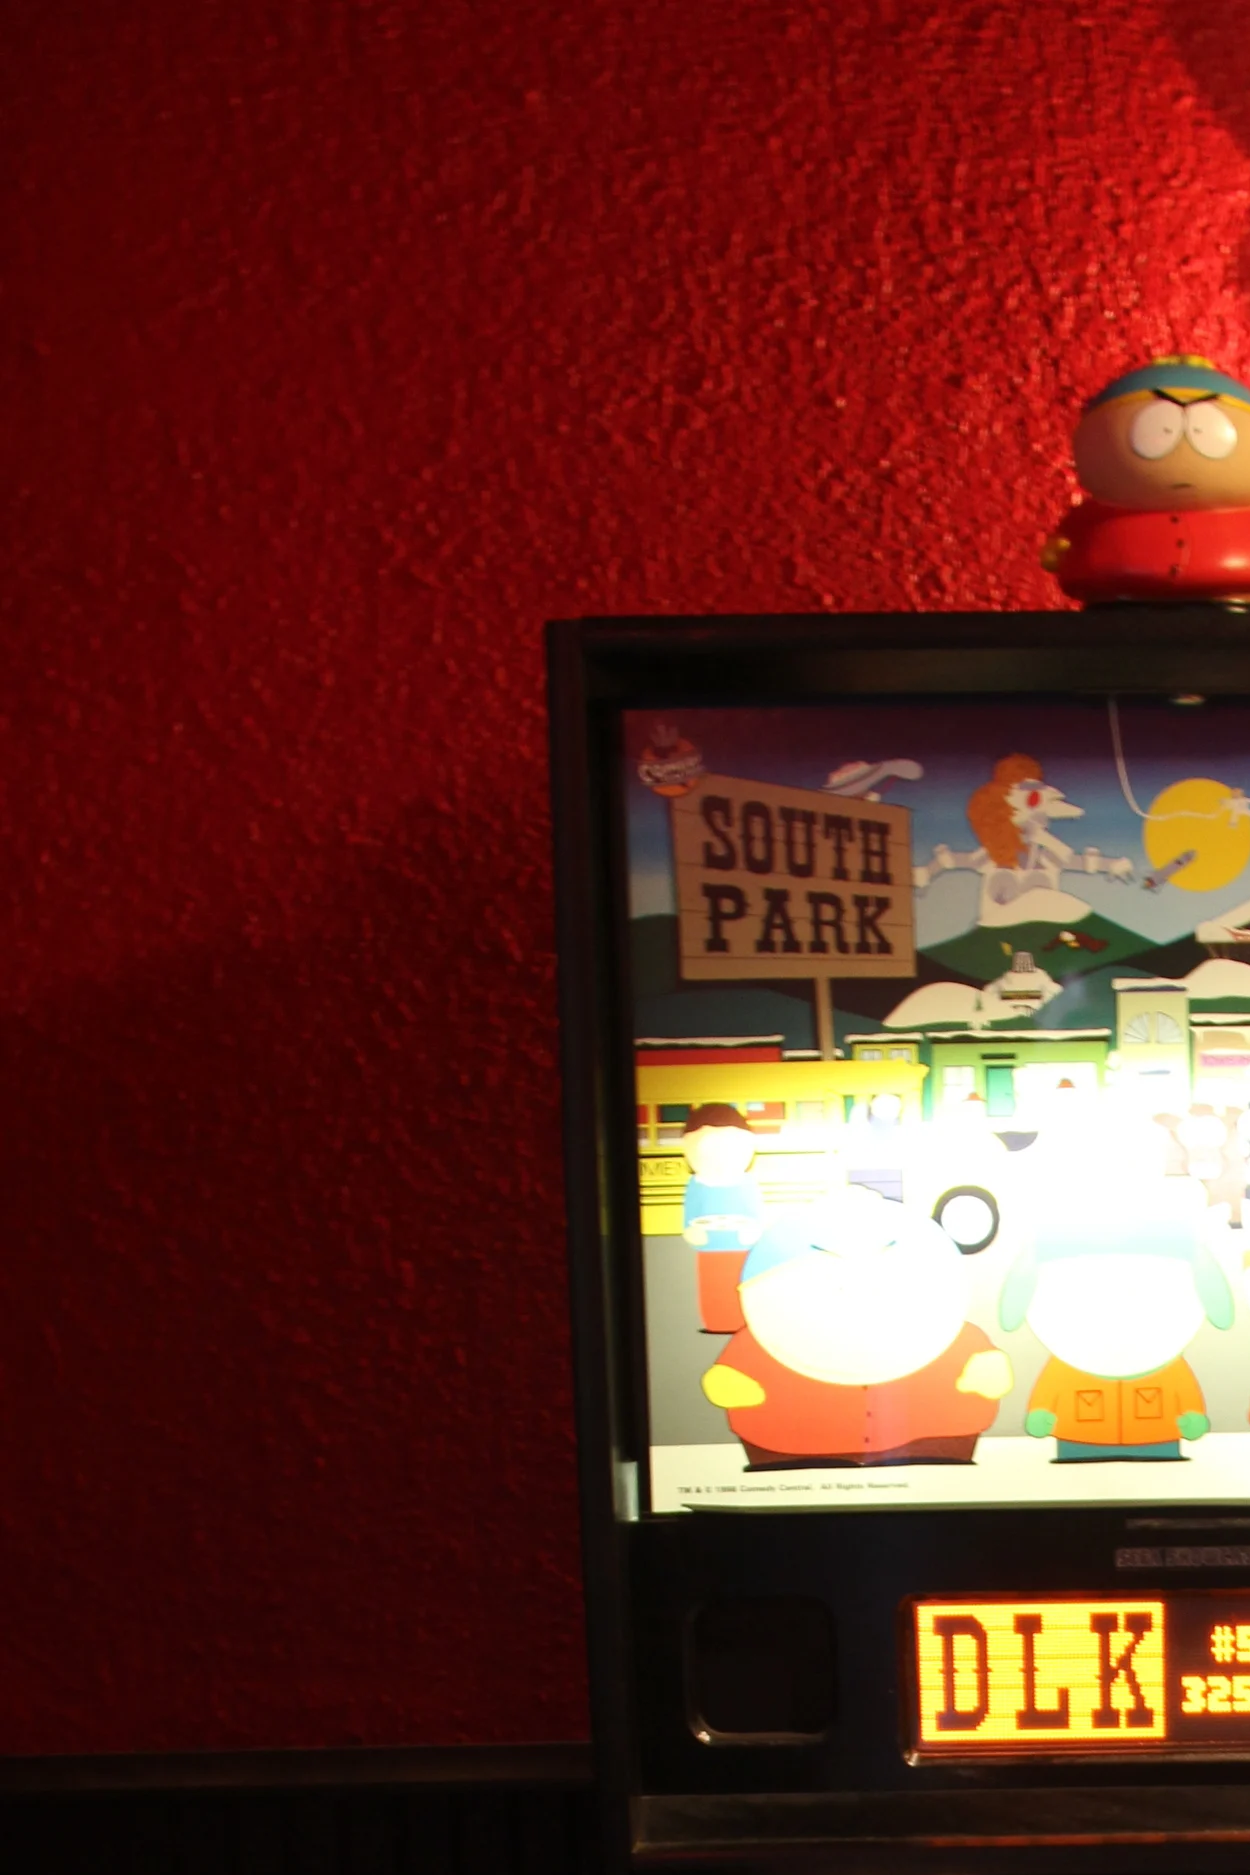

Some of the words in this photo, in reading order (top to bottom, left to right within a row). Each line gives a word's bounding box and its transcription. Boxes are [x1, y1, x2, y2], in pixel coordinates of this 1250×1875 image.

[701, 795, 893, 885] SOUTH
[701, 883, 893, 954] PARK
[933, 1611, 1156, 1731] DLK
